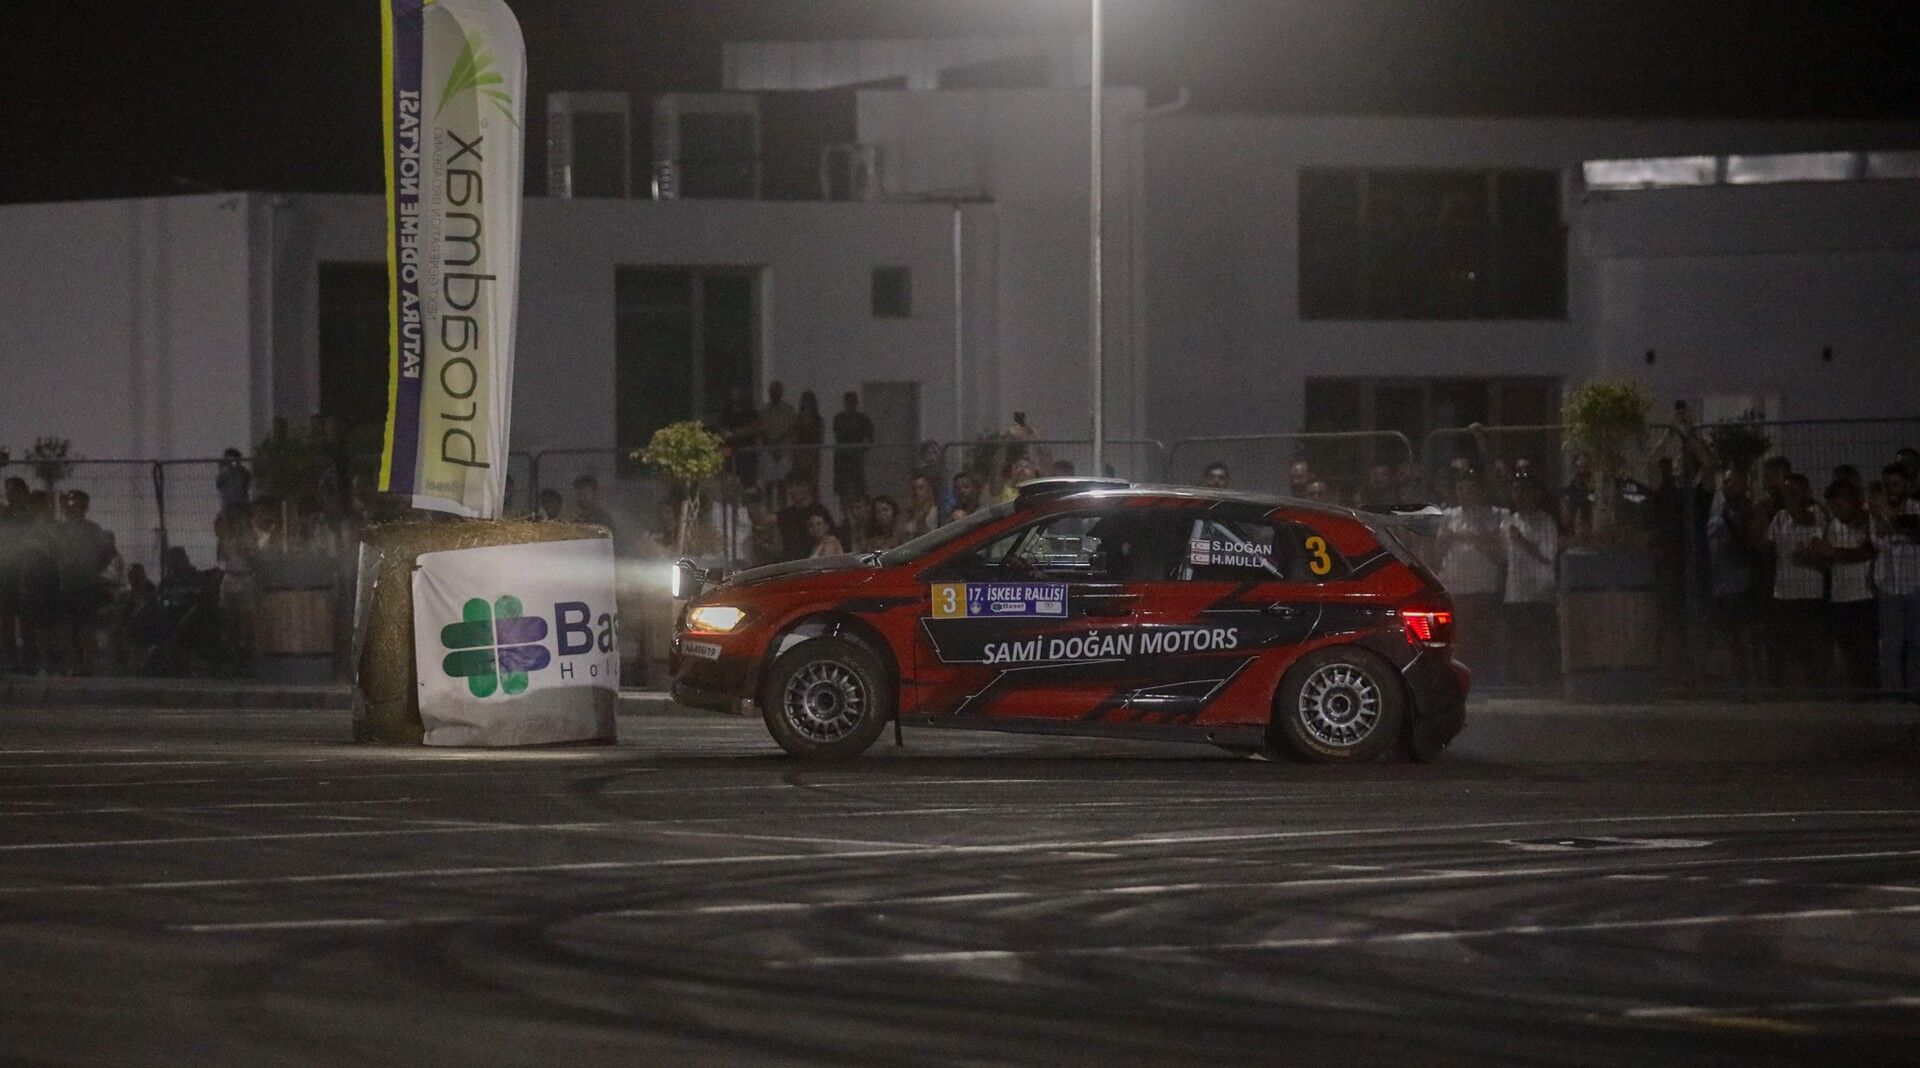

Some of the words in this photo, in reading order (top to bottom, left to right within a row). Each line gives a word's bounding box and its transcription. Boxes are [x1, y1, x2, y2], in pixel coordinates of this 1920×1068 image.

[1211, 540, 1272, 556] S.DOĞAN
[1305, 535, 1332, 576] 3
[942, 587, 957, 614] 3
[969, 588, 984, 601] 17.
[987, 584, 1022, 601] İSKELE
[982, 634, 1043, 665] SAMİ
[1048, 630, 1134, 660] DOĞAN
[1139, 627, 1239, 654] MOTORS
